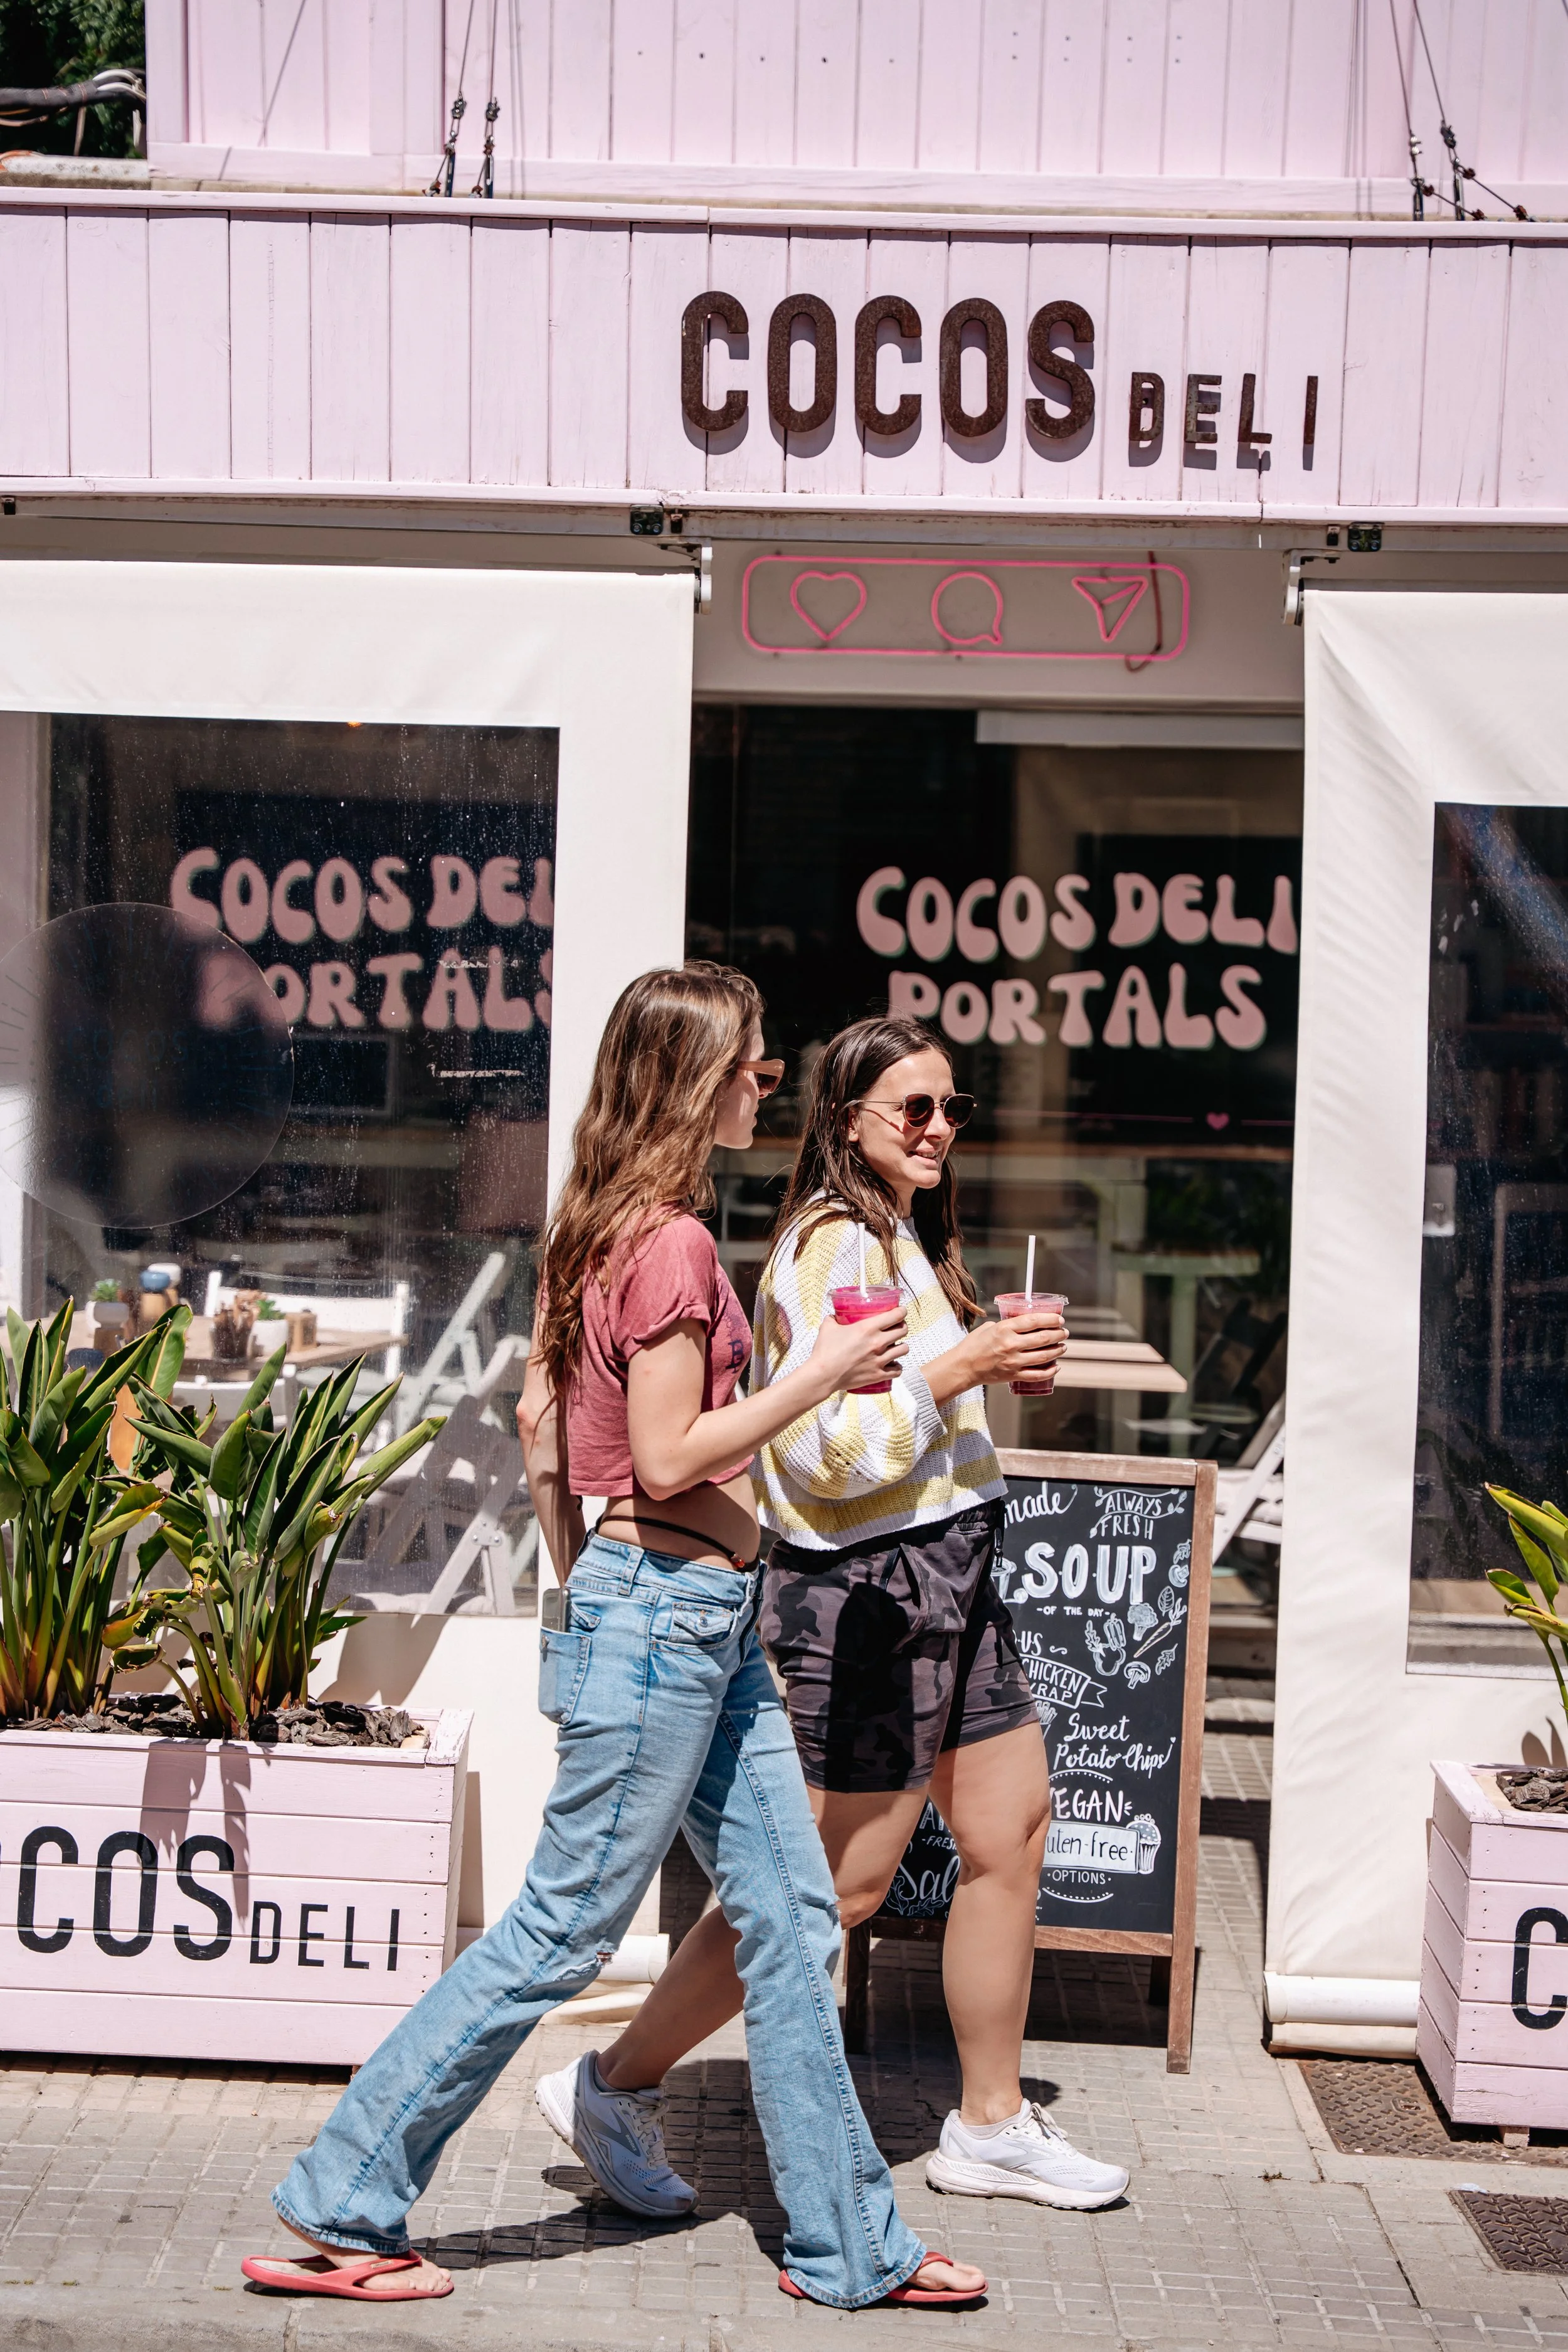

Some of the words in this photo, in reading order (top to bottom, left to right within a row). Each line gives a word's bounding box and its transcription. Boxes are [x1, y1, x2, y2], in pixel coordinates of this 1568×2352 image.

[681, 291, 1095, 439] COCOS
[1130, 372, 1318, 445] DELI
[170, 846, 413, 945] COCOS
[856, 866, 1095, 962] COCOS
[1108, 872, 1298, 955] DELI
[886, 962, 1267, 1050] PORTALS
[1105, 1492, 1162, 1516] ALWAYS
[1101, 1513, 1153, 1540] FRESH
[1063, 1606, 1083, 1616] THE
[1030, 1682, 1073, 1702] RAP
[1063, 1712, 1130, 1742] Sweet
[1054, 1743, 1121, 1771] Potato
[1122, 1742, 1173, 1779] Chips
[1052, 1869, 1106, 1885] OPTIONS
[250, 1901, 400, 1971] DELI
